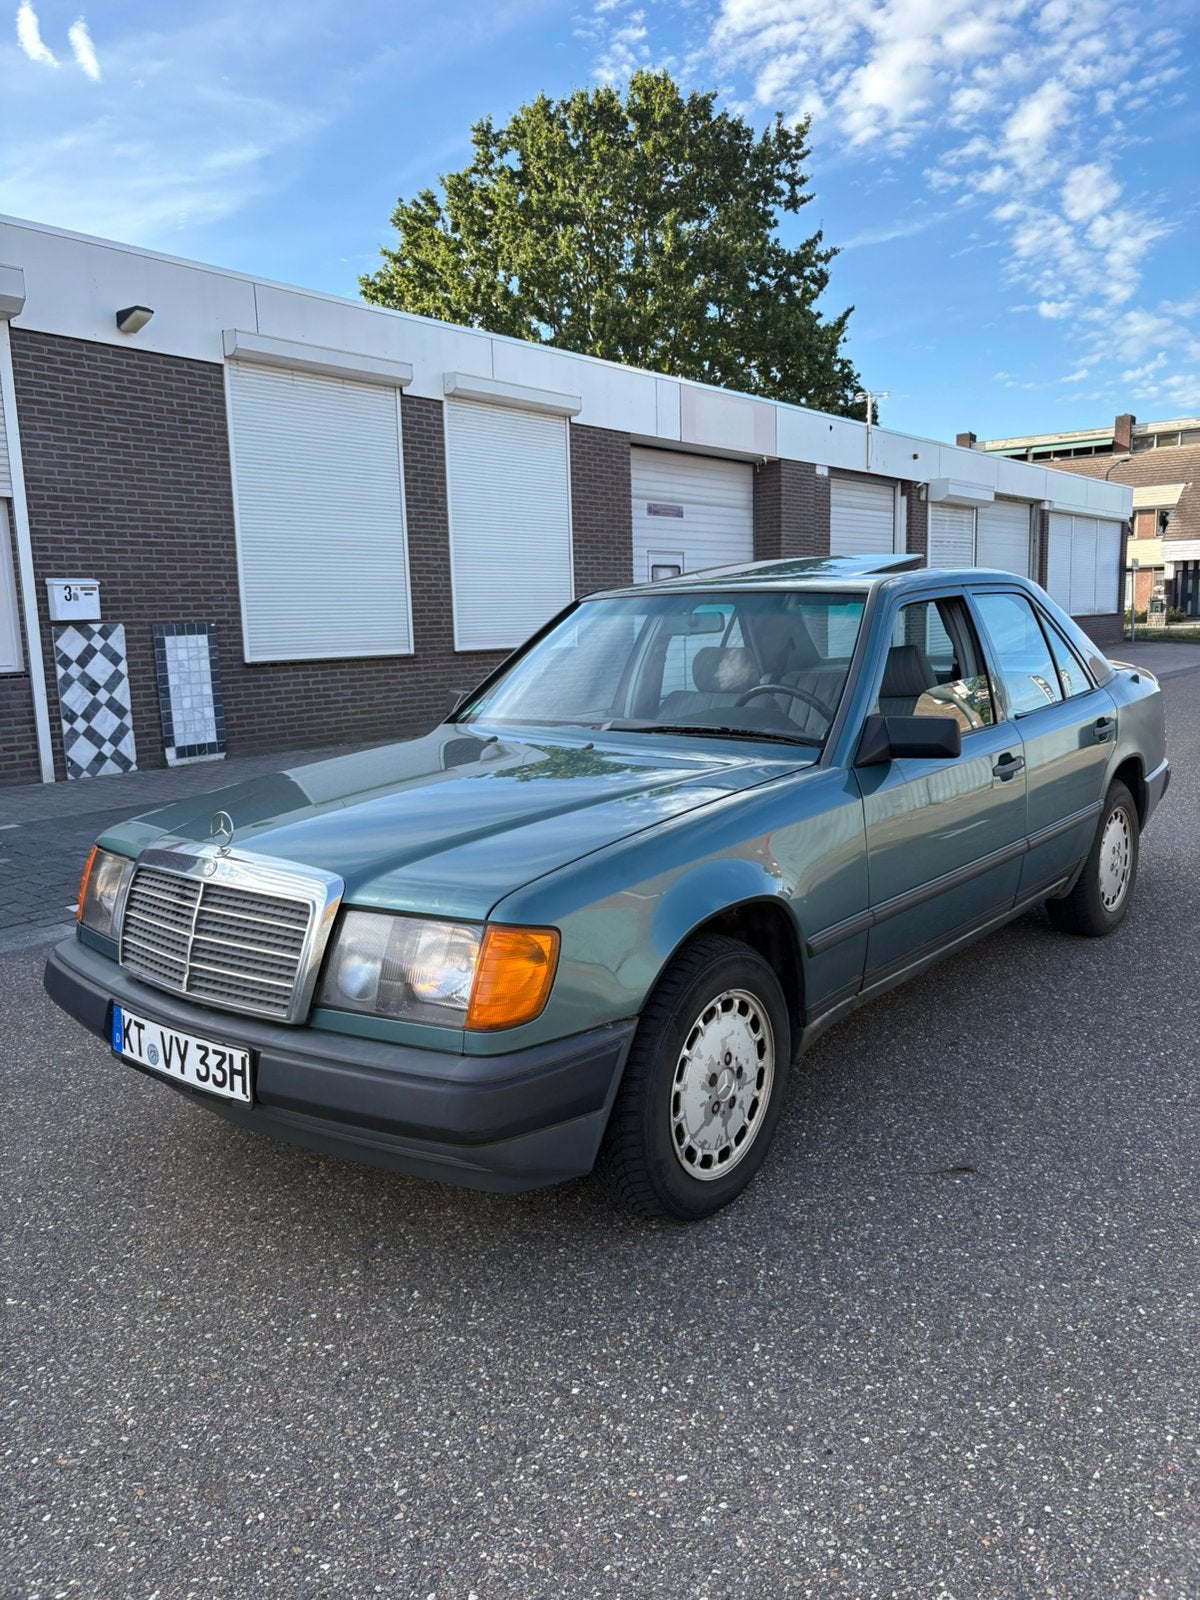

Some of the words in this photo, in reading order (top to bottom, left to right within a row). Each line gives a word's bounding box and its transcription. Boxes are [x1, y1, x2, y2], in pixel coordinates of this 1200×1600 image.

[64, 585, 72, 602] 3
[122, 1015, 145, 1058] KT
[160, 1031, 189, 1075] VY
[196, 1044, 247, 1095] 33H
